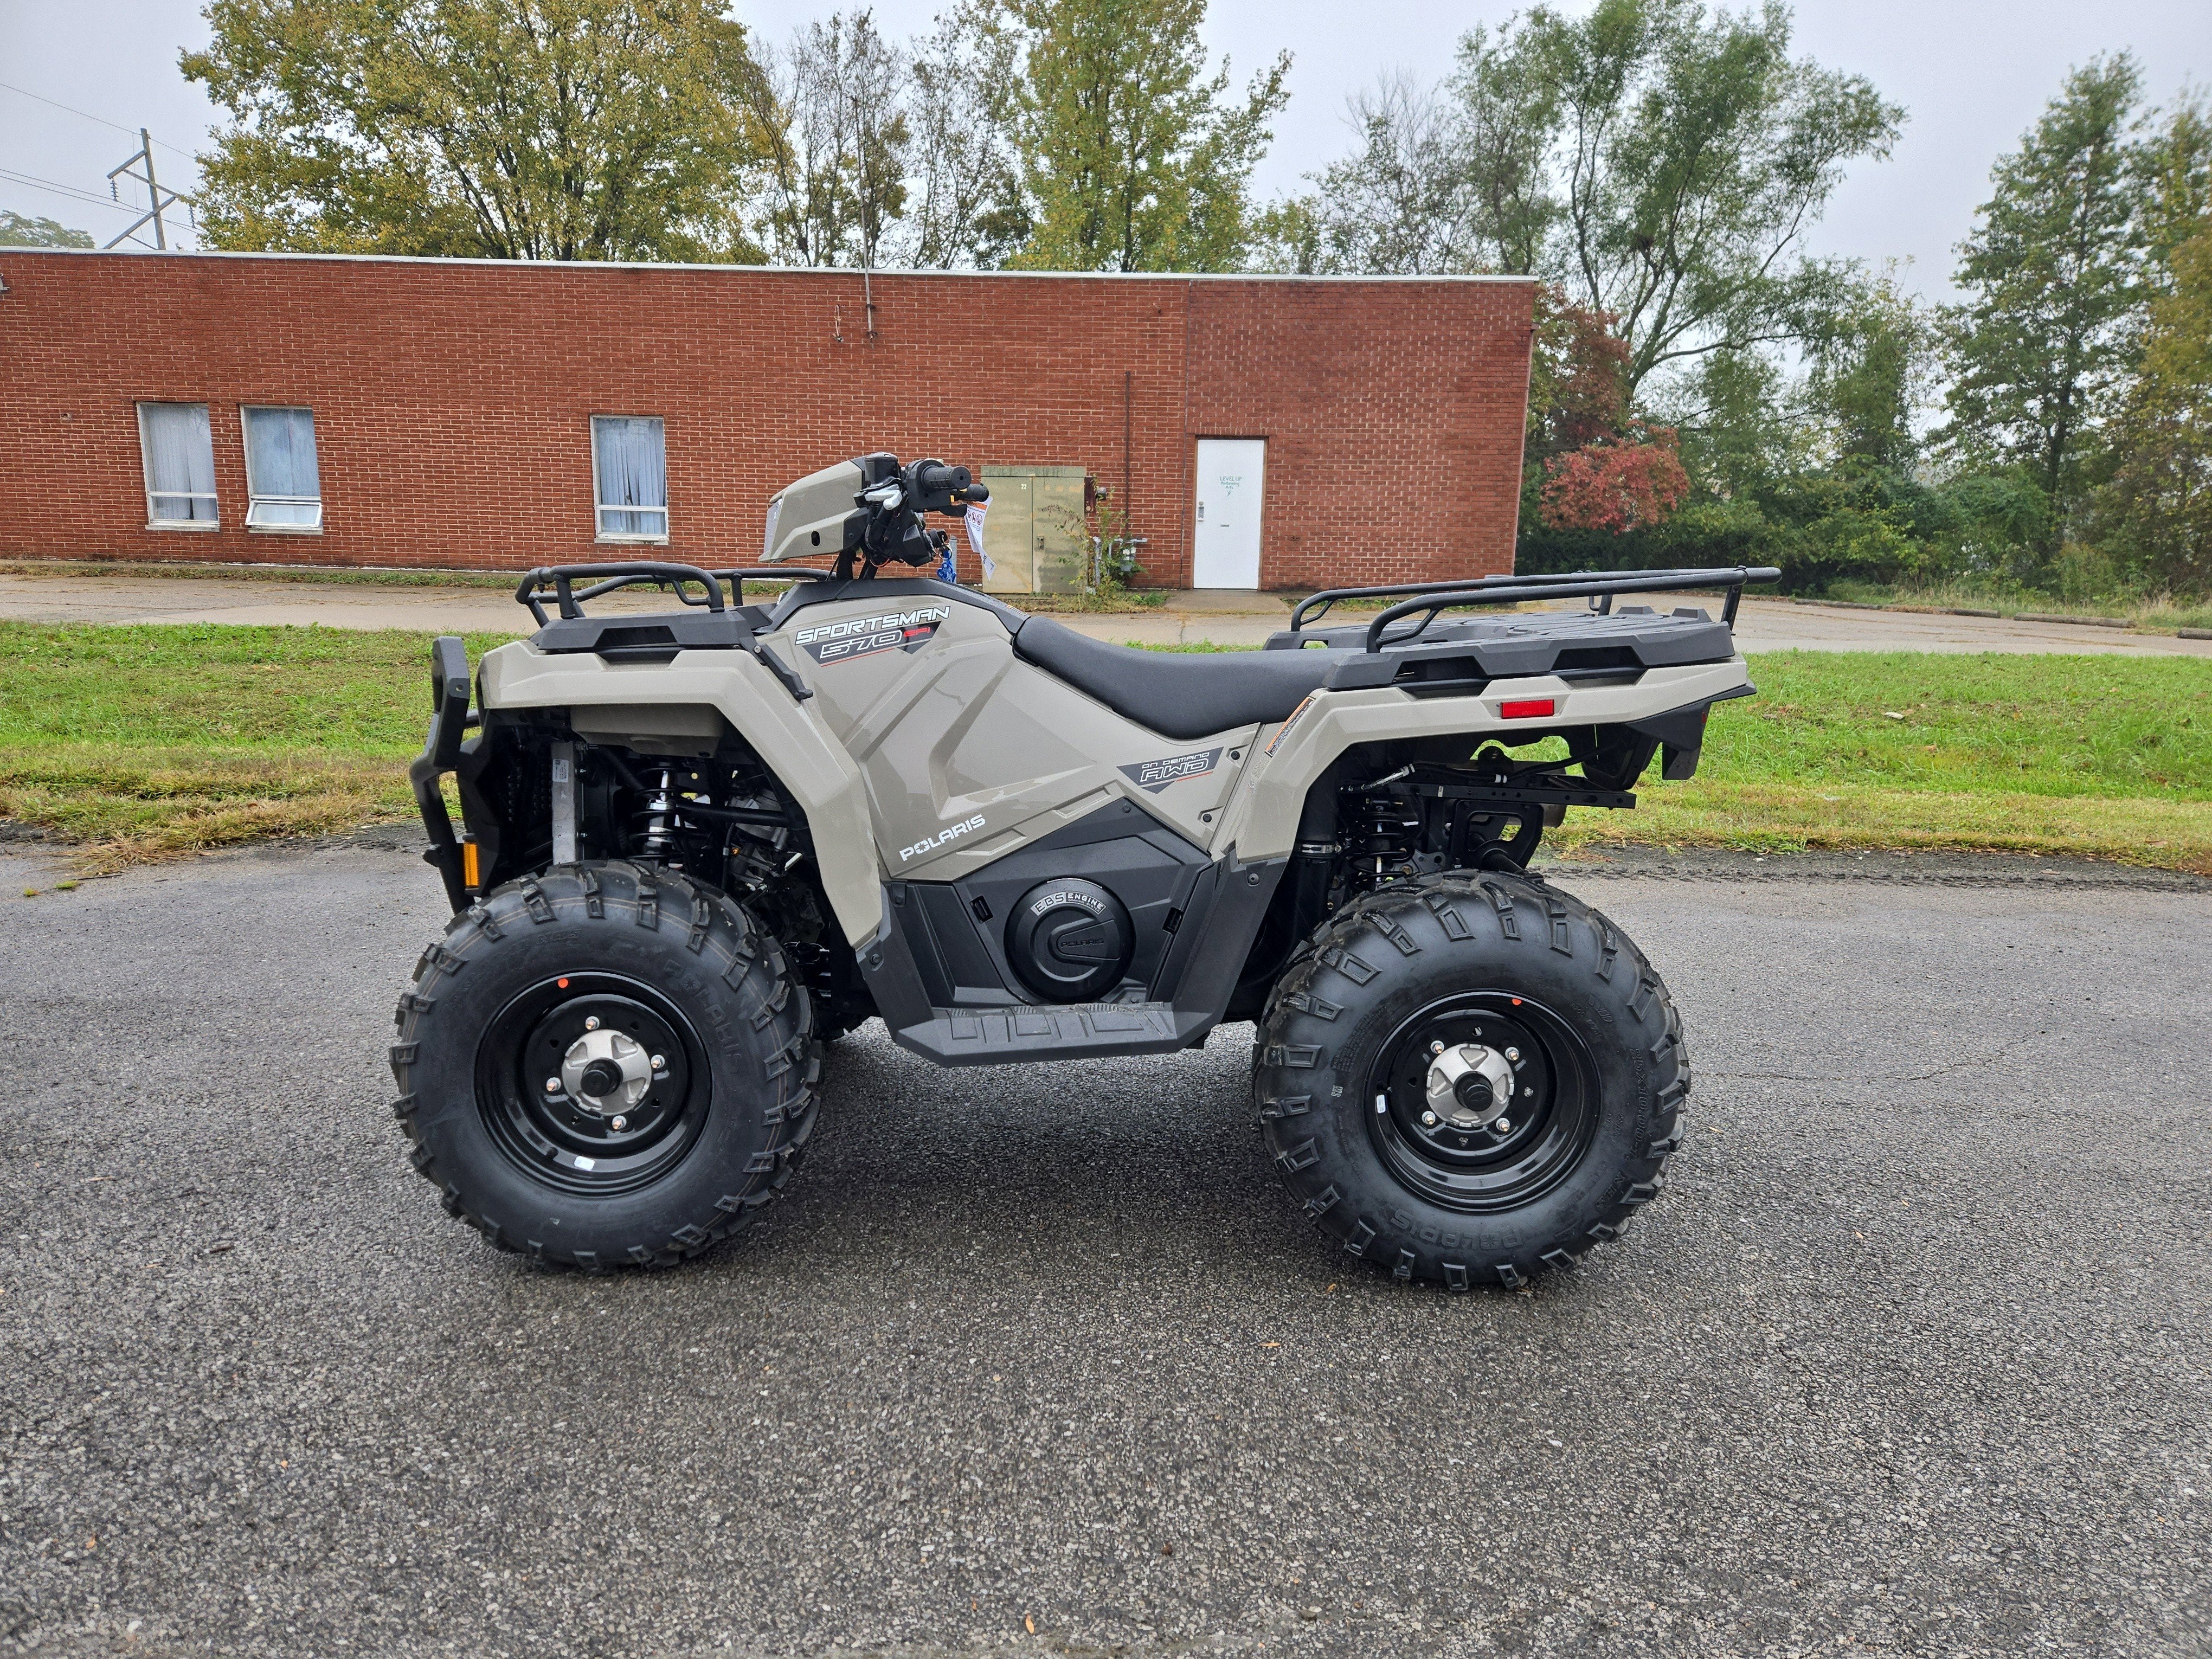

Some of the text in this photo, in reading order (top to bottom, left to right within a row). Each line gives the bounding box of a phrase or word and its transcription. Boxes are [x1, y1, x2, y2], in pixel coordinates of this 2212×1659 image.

[795, 606, 950, 645] SPORTSMAN
[819, 629, 902, 659] 570
[1140, 758, 1208, 782] AWD
[1162, 751, 1210, 766] DEMAND
[899, 814, 986, 861] POLARIS
[1034, 892, 1103, 912] EBS ENGINE
[1060, 938, 1104, 948] POLARIS
[1391, 1208, 1522, 1250] POLARIS
